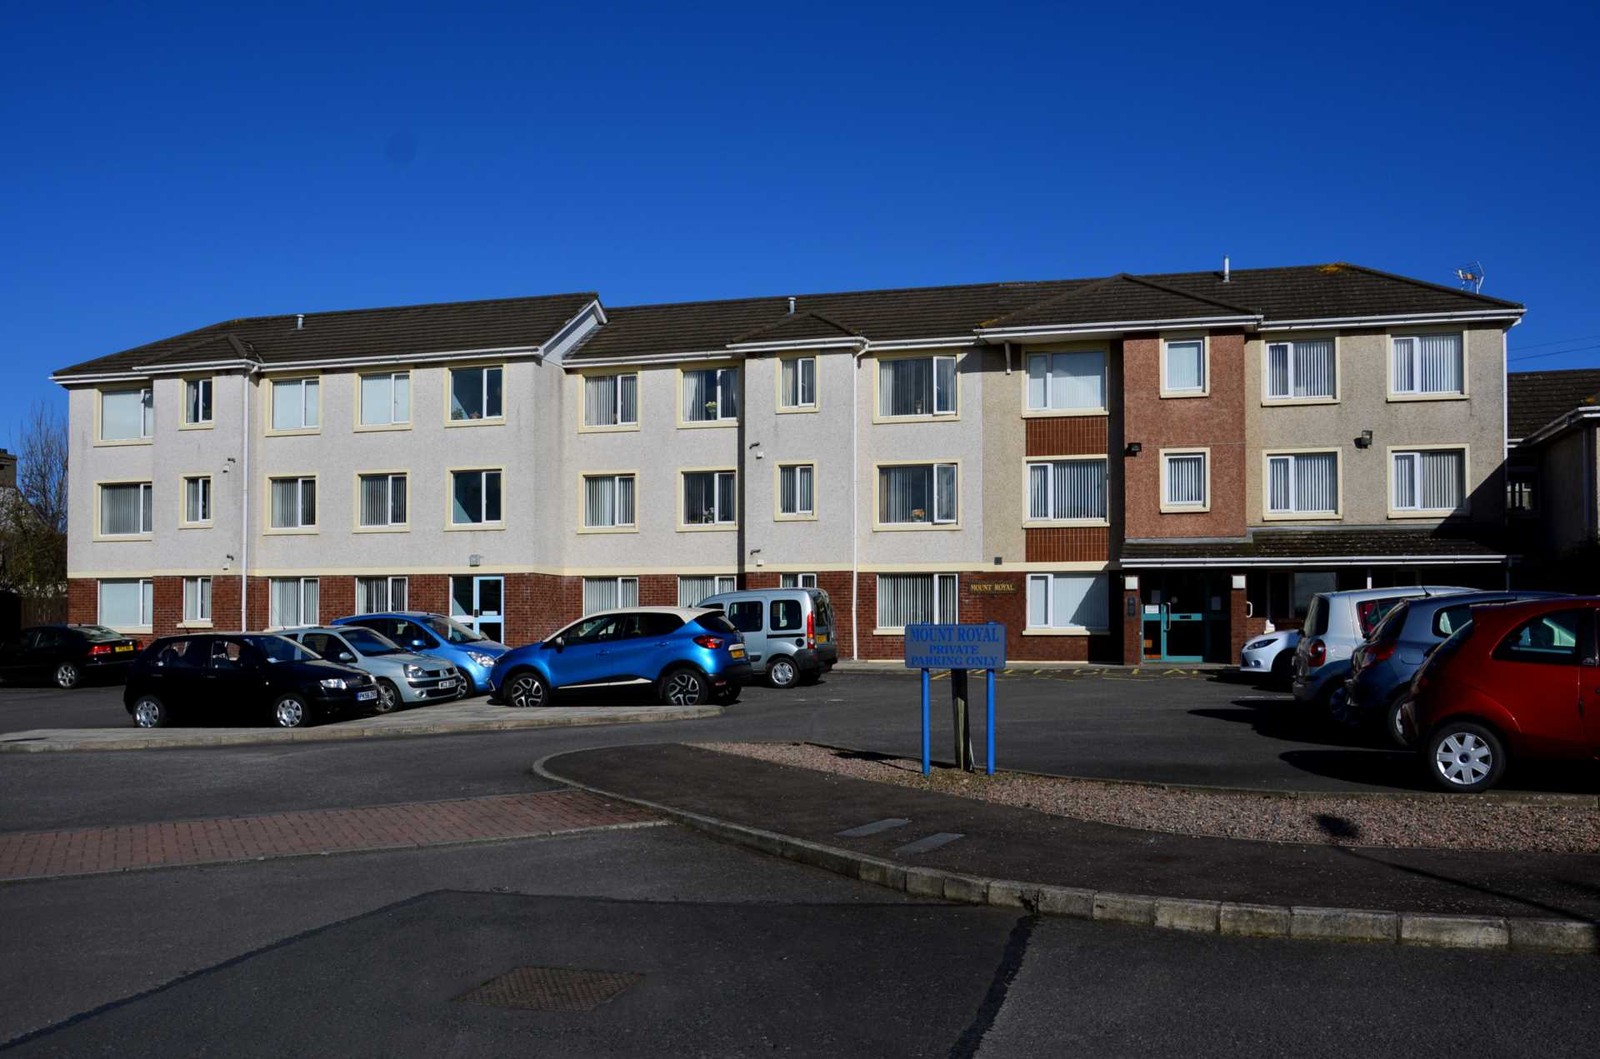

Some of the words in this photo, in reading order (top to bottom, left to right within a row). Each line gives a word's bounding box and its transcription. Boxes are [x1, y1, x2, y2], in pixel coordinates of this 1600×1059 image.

[970, 583, 992, 592] MOUNT
[994, 583, 1015, 591] ROYAL
[910, 627, 954, 642] MOUNT
[958, 627, 999, 642] ROYAL
[929, 645, 979, 655] PRIVATE
[911, 656, 962, 666] PARKING
[966, 656, 999, 666] ONLY
